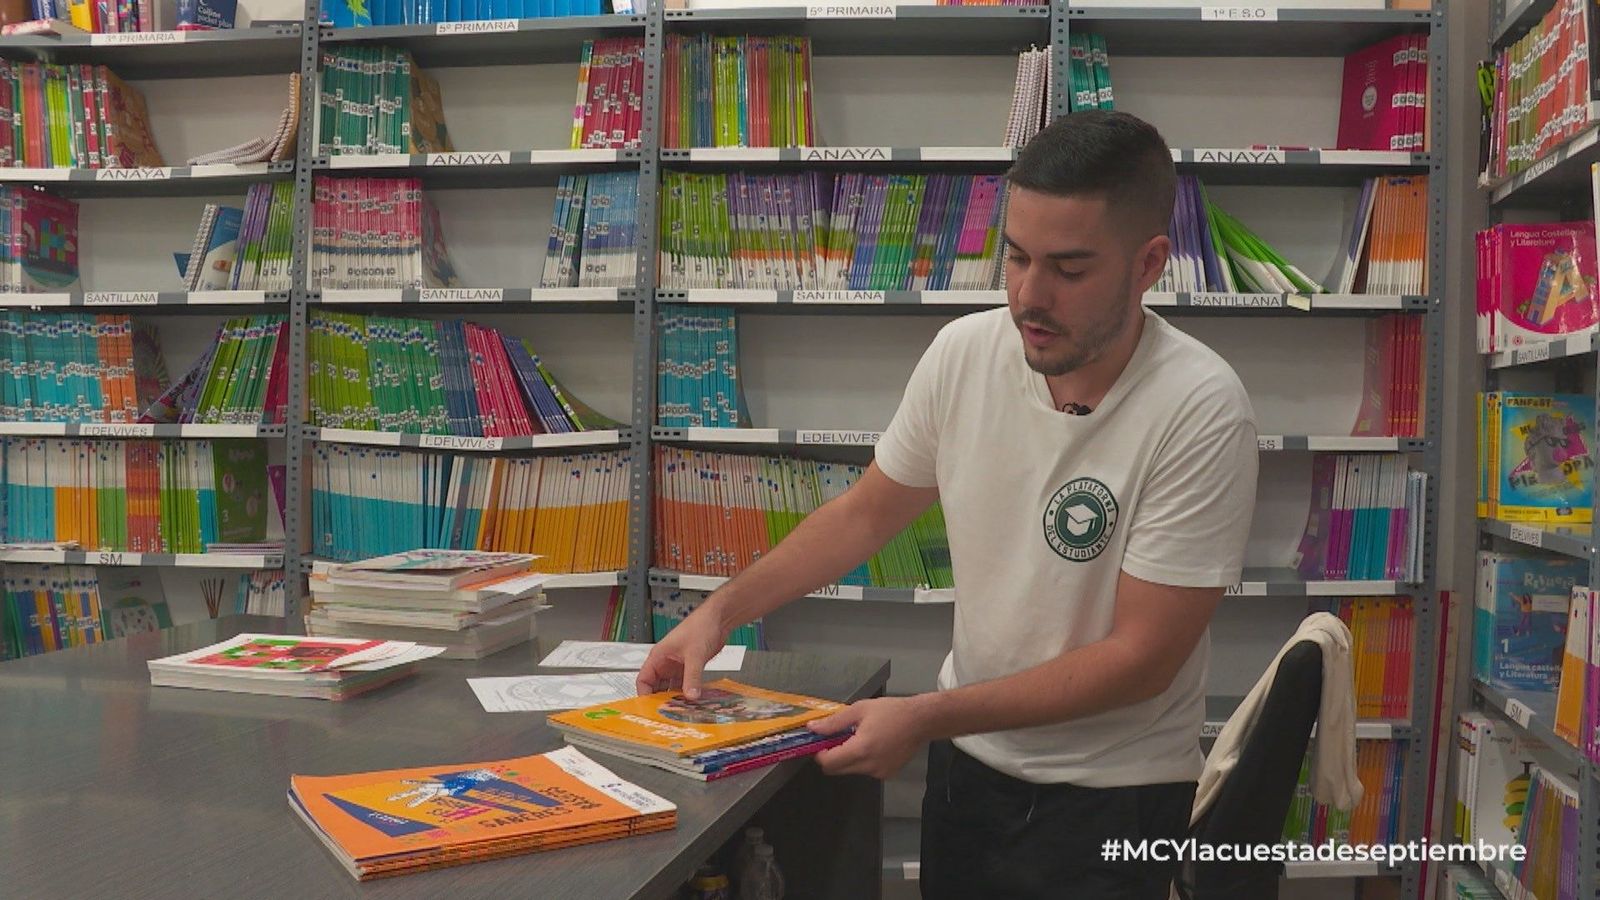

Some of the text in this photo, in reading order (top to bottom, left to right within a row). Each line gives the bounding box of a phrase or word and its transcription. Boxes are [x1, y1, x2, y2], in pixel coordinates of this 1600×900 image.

[826, 6, 893, 16] PRIMARIA
[454, 21, 516, 32] PRIMARIA
[119, 33, 176, 43] PRIMARIA
[432, 153, 504, 165] ANAYA
[807, 148, 886, 160] ANAYA
[1200, 151, 1279, 164] ANAYA
[101, 168, 165, 179] ANAYA
[1510, 230, 1540, 240] Lengua
[86, 293, 156, 303] SANTILLANA
[422, 290, 500, 300] SANTILLANA
[797, 291, 883, 300] SANTILLANA
[1192, 295, 1280, 307] SANTILLANA
[84, 426, 147, 436] EDELVIVES
[425, 436, 496, 449] EDELVIVES
[803, 433, 880, 443] EDELVIVES
[1054, 481, 1115, 513] LA PLATAFORMA
[1047, 525, 1109, 559] DEL ESTUDIANTE
[100, 553, 123, 565] SM
[1501, 638, 1510, 654] 1
[1506, 671, 1548, 681] Literatura
[1511, 703, 1522, 721] SM
